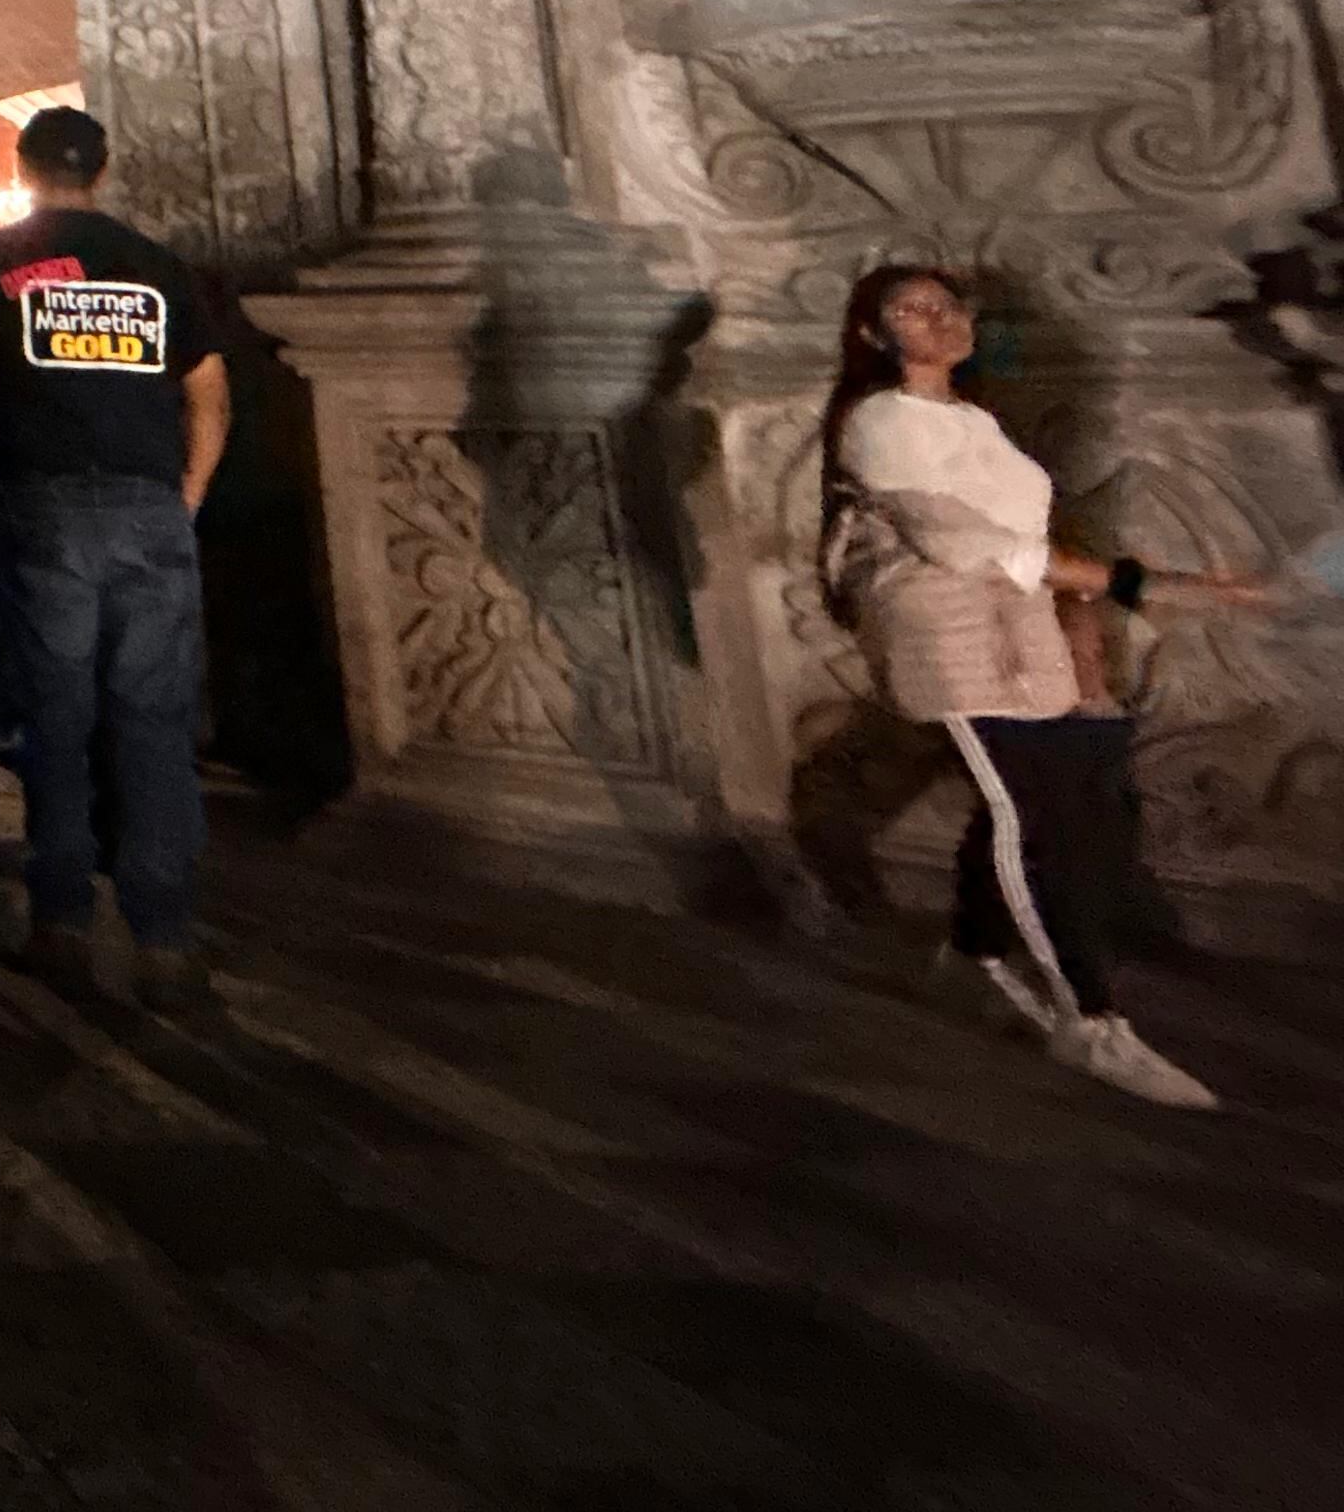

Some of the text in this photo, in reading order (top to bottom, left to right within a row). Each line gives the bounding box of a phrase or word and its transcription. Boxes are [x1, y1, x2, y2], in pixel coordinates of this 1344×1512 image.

[44, 287, 146, 314] Internet
[35, 310, 157, 342] Marketing
[51, 332, 143, 362] GOLD
